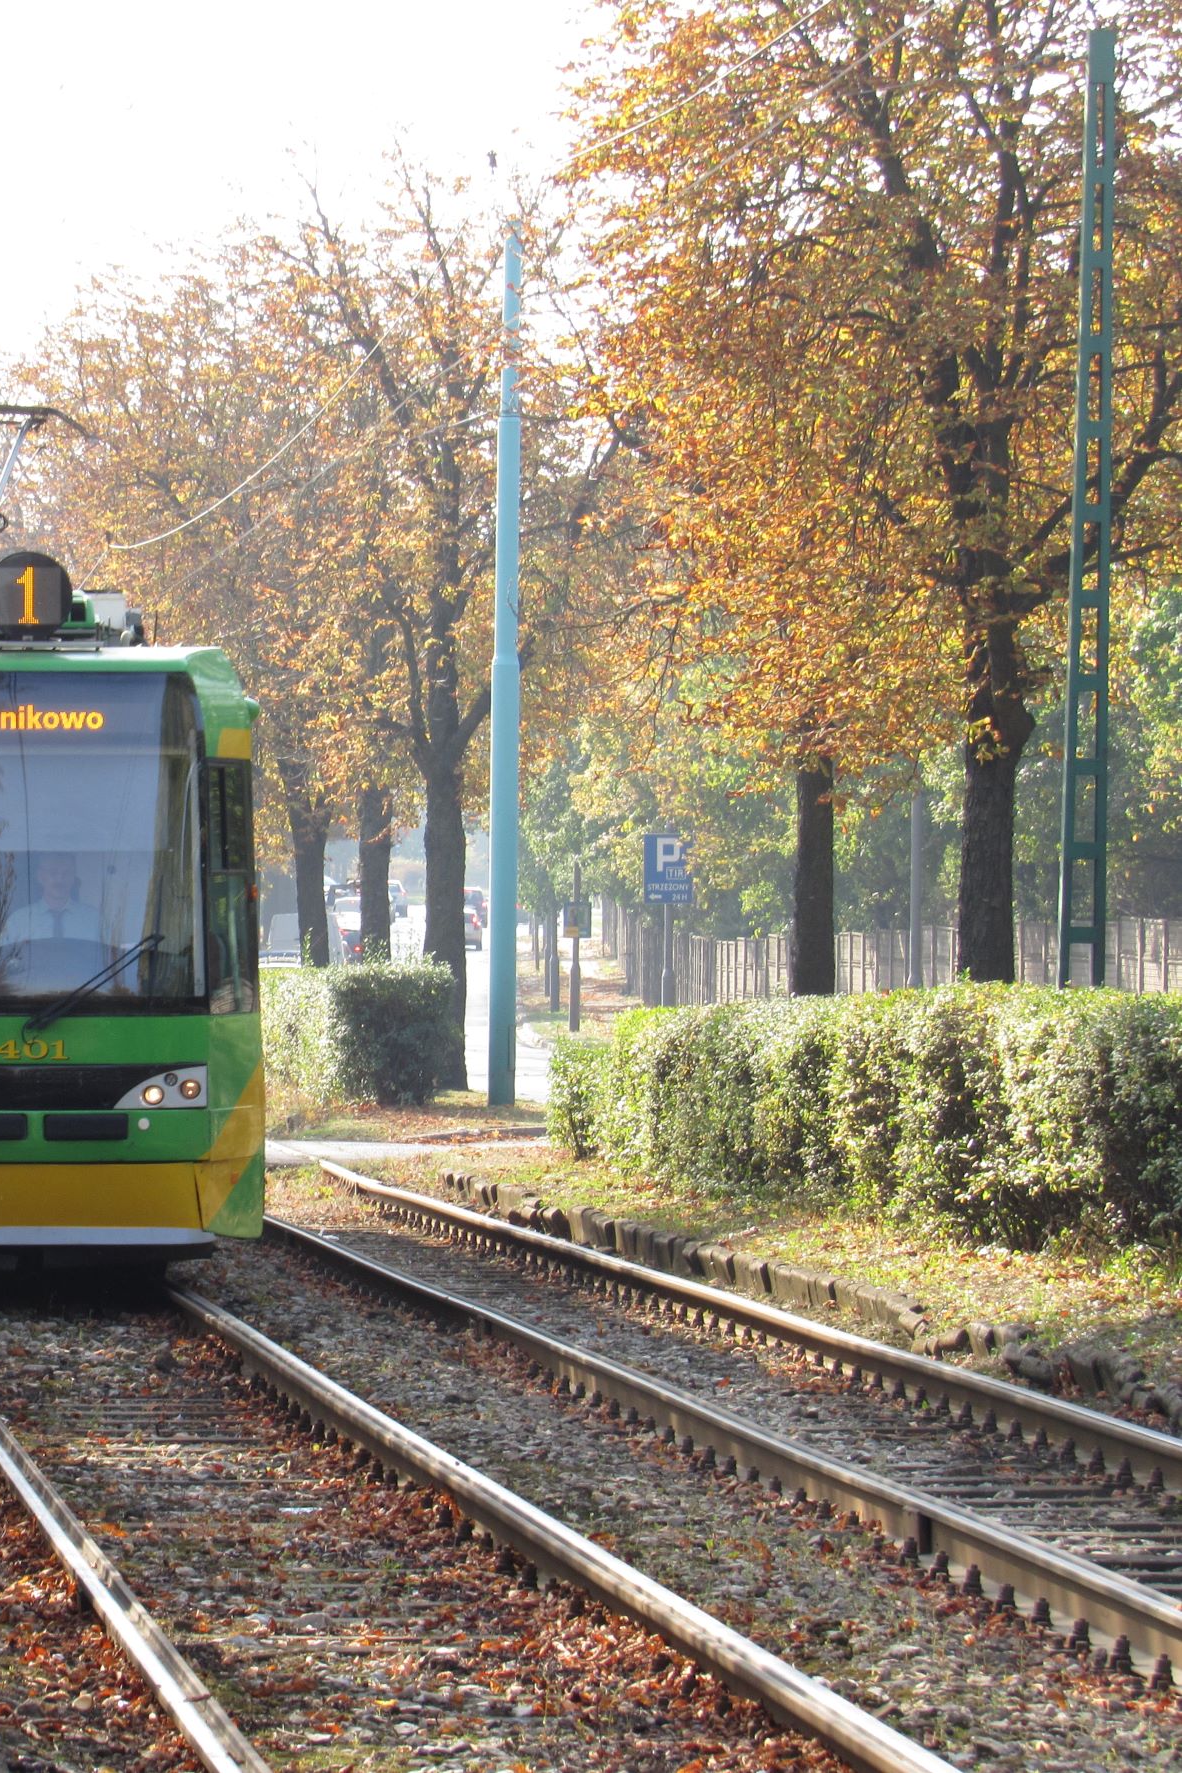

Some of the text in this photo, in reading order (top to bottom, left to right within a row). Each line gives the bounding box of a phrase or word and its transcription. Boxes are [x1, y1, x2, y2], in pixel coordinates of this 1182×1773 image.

[16, 566, 39, 624] 1
[656, 837, 680, 872] P
[668, 868, 684, 878] TIR
